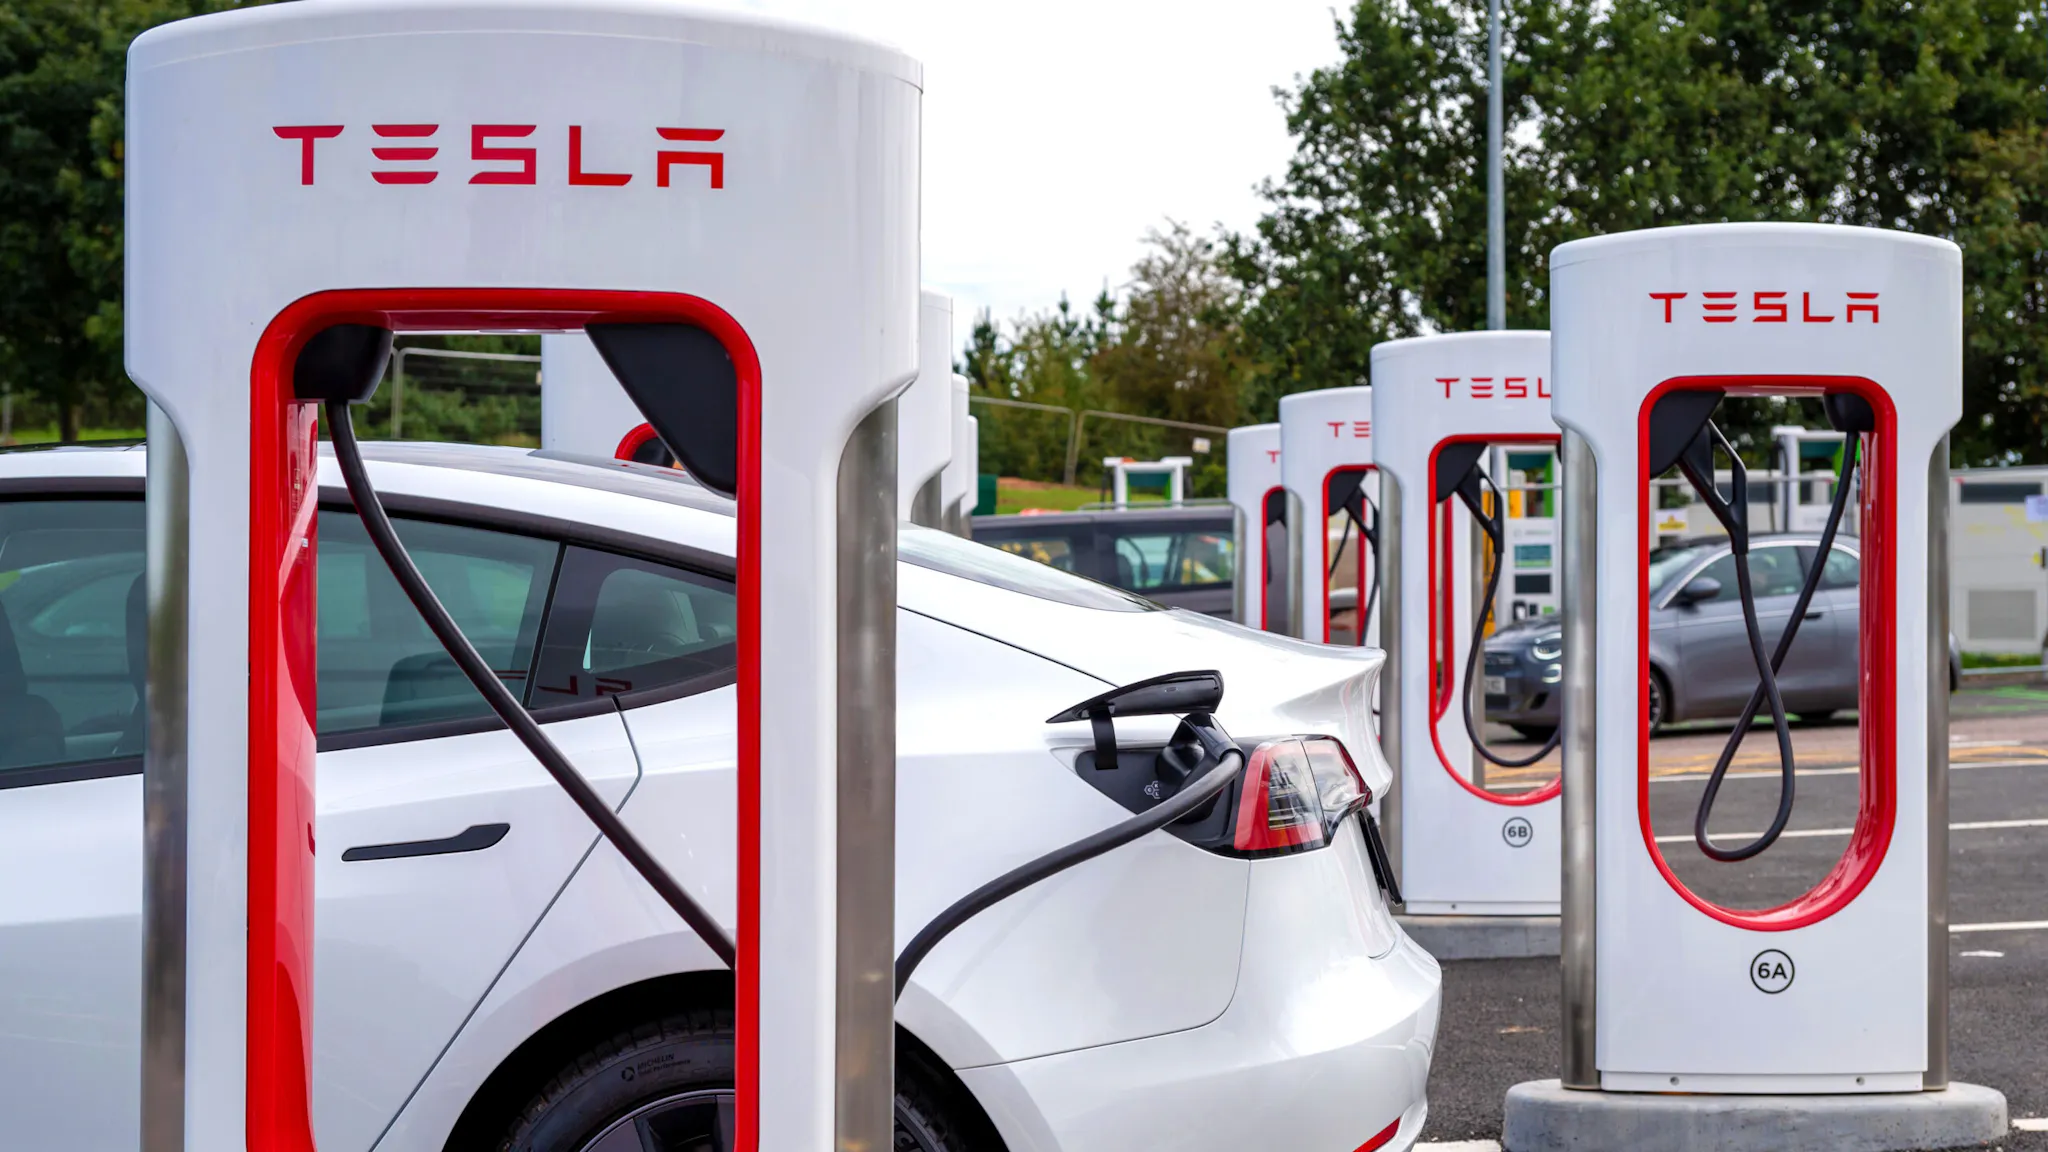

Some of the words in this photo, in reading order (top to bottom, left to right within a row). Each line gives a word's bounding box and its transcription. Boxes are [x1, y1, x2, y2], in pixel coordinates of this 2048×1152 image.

[273, 124, 724, 189] TESLA
[1650, 292, 1880, 323] TESLA
[1436, 377, 1550, 399] TESL
[1507, 825, 1528, 838] 6B
[1757, 962, 1788, 980] 6A
[637, 1053, 675, 1070] MICHELIN
